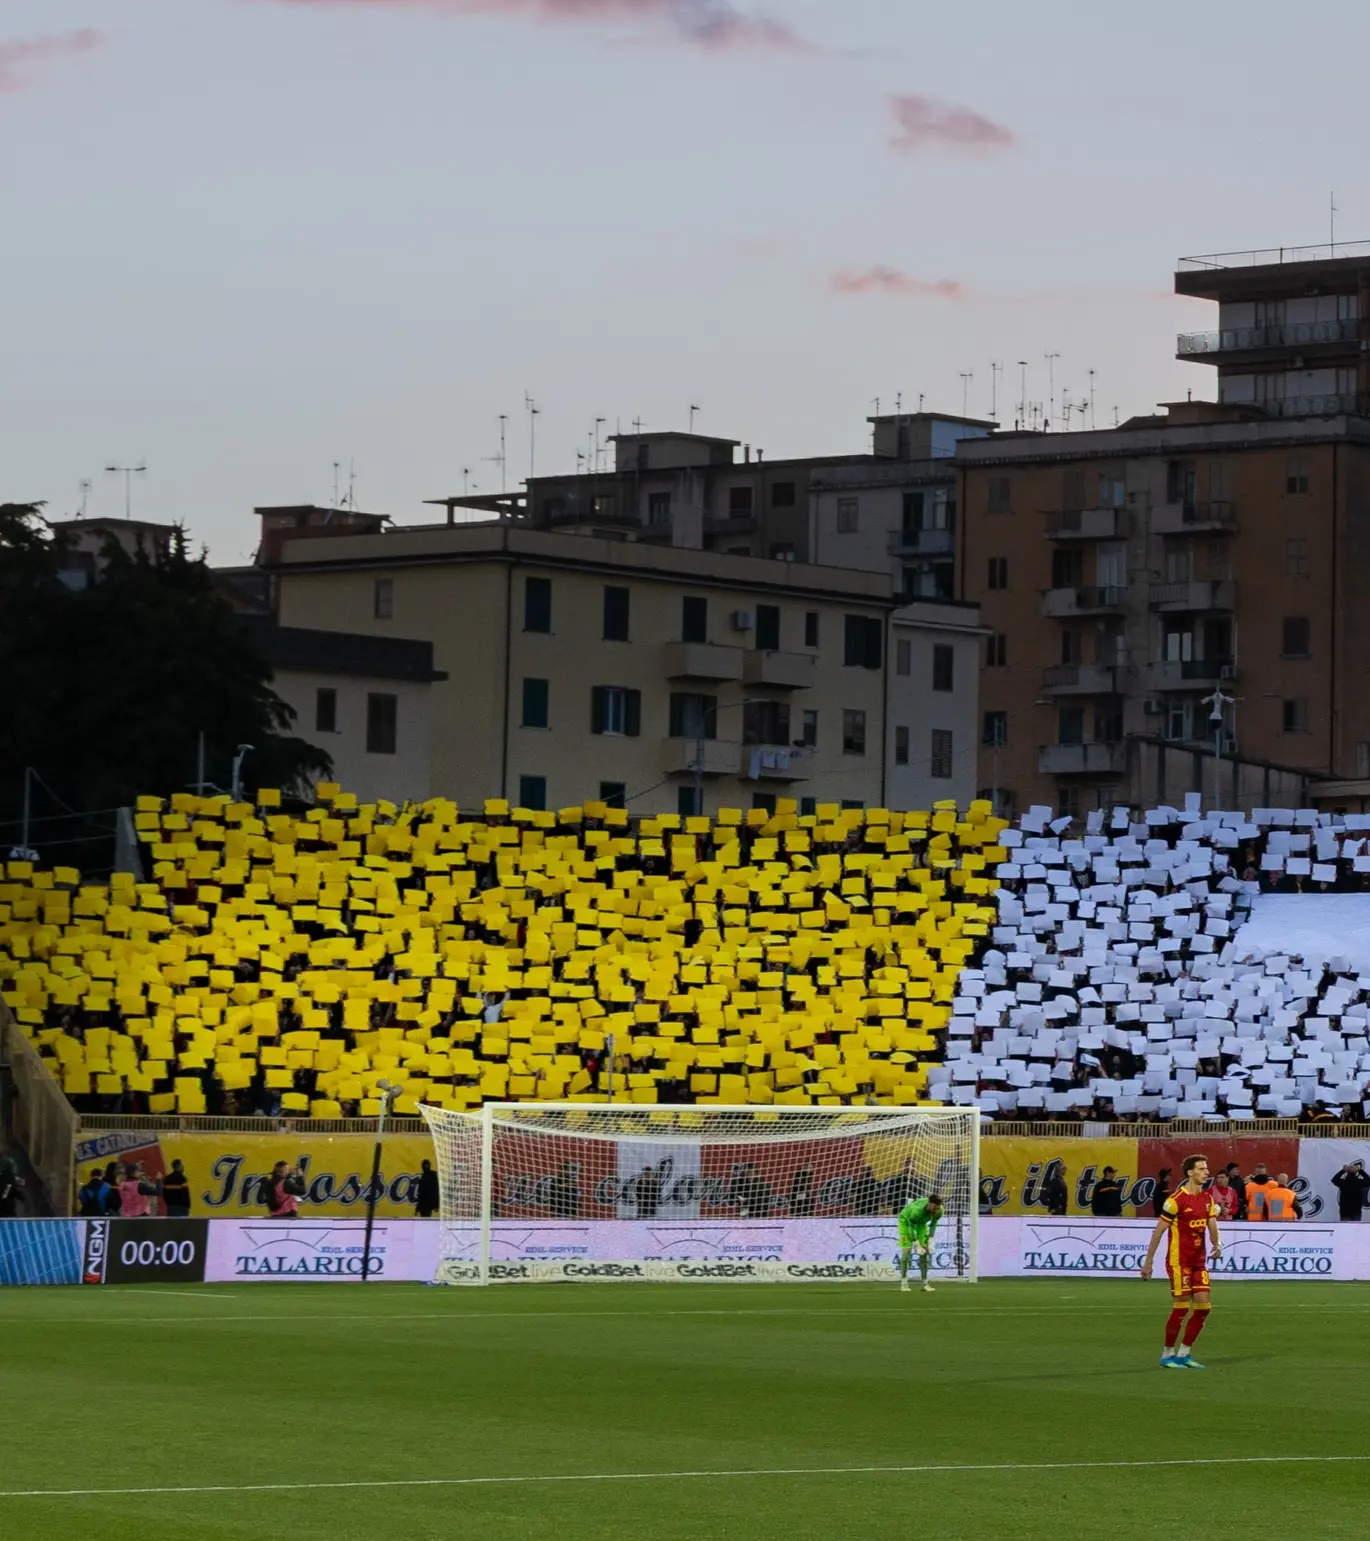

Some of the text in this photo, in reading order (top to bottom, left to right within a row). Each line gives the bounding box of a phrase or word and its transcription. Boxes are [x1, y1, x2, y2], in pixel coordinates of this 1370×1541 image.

[1189, 1219, 1207, 1228] coo
[121, 1240, 195, 1265] 00:00
[346, 1246, 386, 1254] SERICE
[236, 1256, 384, 1274] TALARICO
[446, 1264, 531, 1279] GolBet
[1207, 1256, 1332, 1273] TALARICO
[1201, 1270, 1210, 1285] 8
